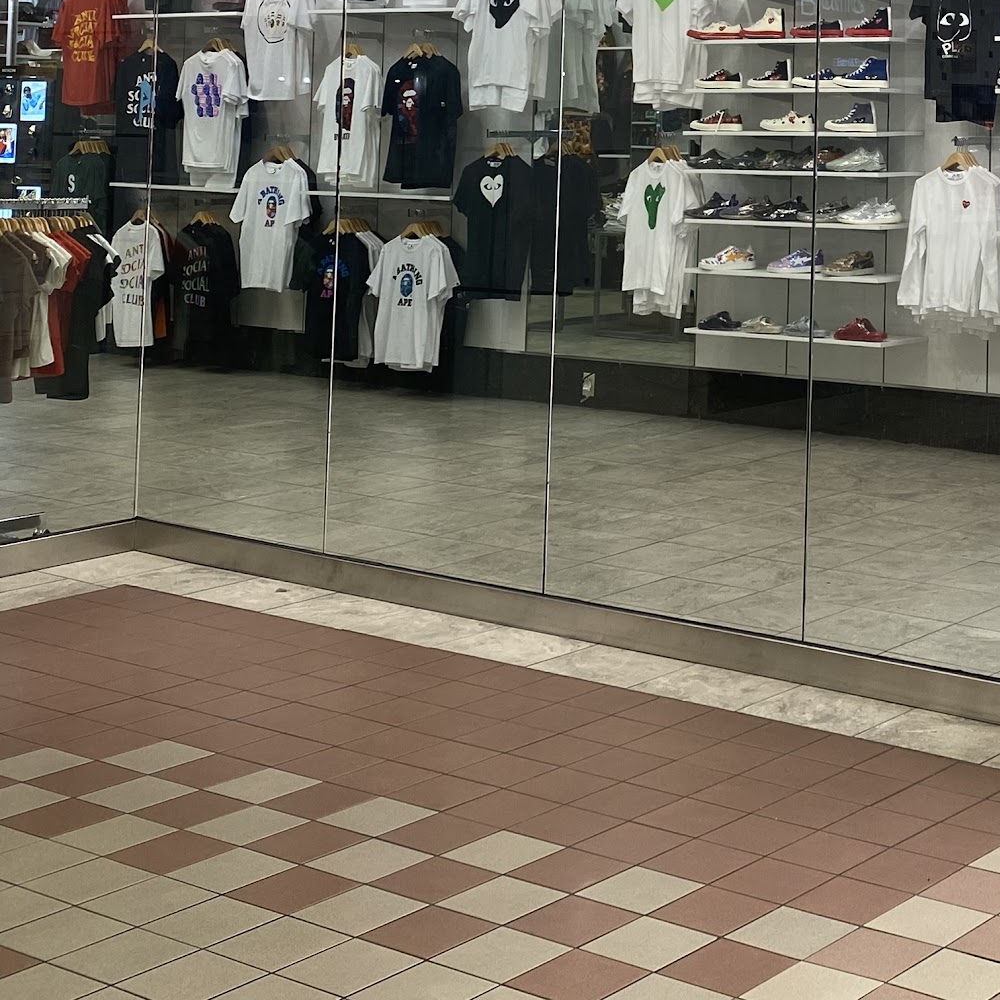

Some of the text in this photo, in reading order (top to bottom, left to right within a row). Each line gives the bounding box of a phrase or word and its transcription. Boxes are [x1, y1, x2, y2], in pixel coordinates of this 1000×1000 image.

[67, 173, 76, 194] S
[125, 244, 144, 259] ANT
[184, 293, 206, 307] CLUB
[397, 298, 413, 307] APE
